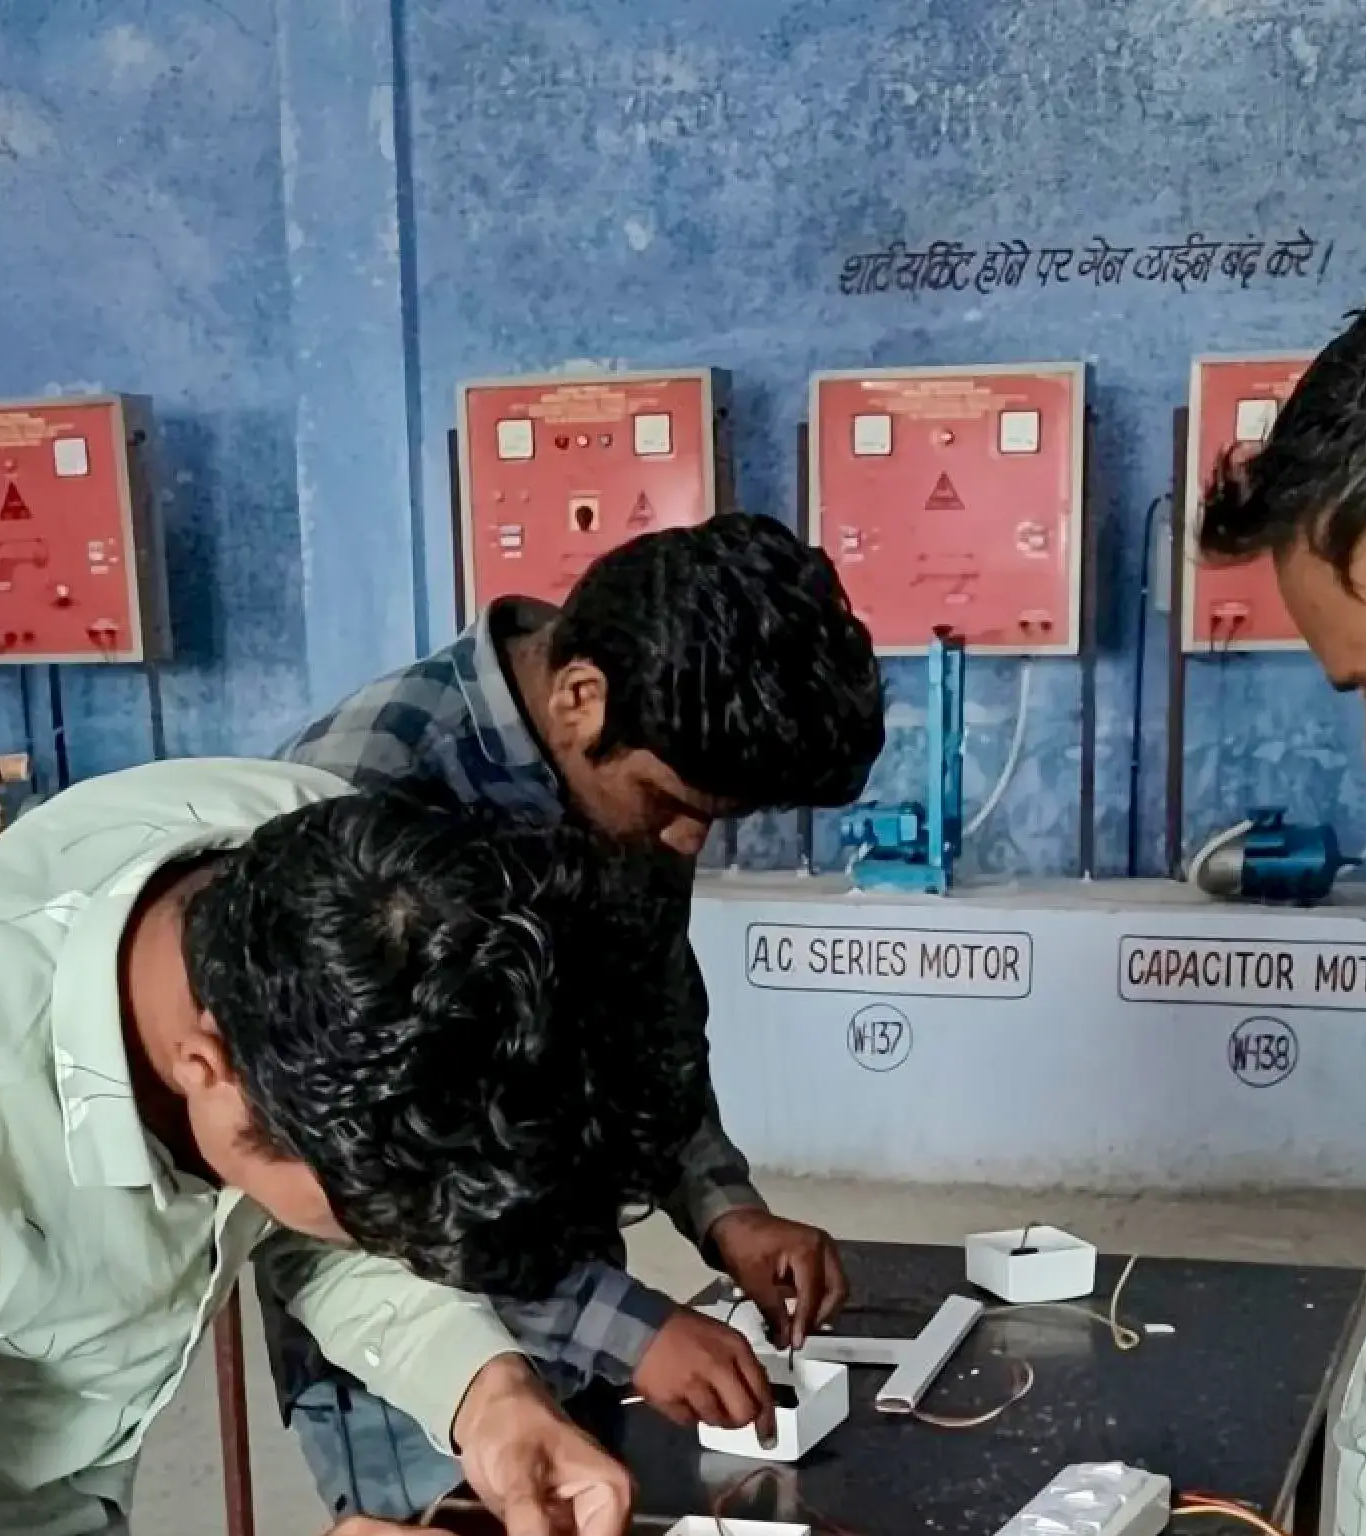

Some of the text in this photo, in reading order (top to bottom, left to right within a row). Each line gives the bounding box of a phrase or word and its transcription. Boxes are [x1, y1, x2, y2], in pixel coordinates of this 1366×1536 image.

[1037, 248, 1073, 287] पर
[751, 935, 1020, 982] AC SERIES MOTOR
[1128, 949, 1295, 991] CAPACITOR
